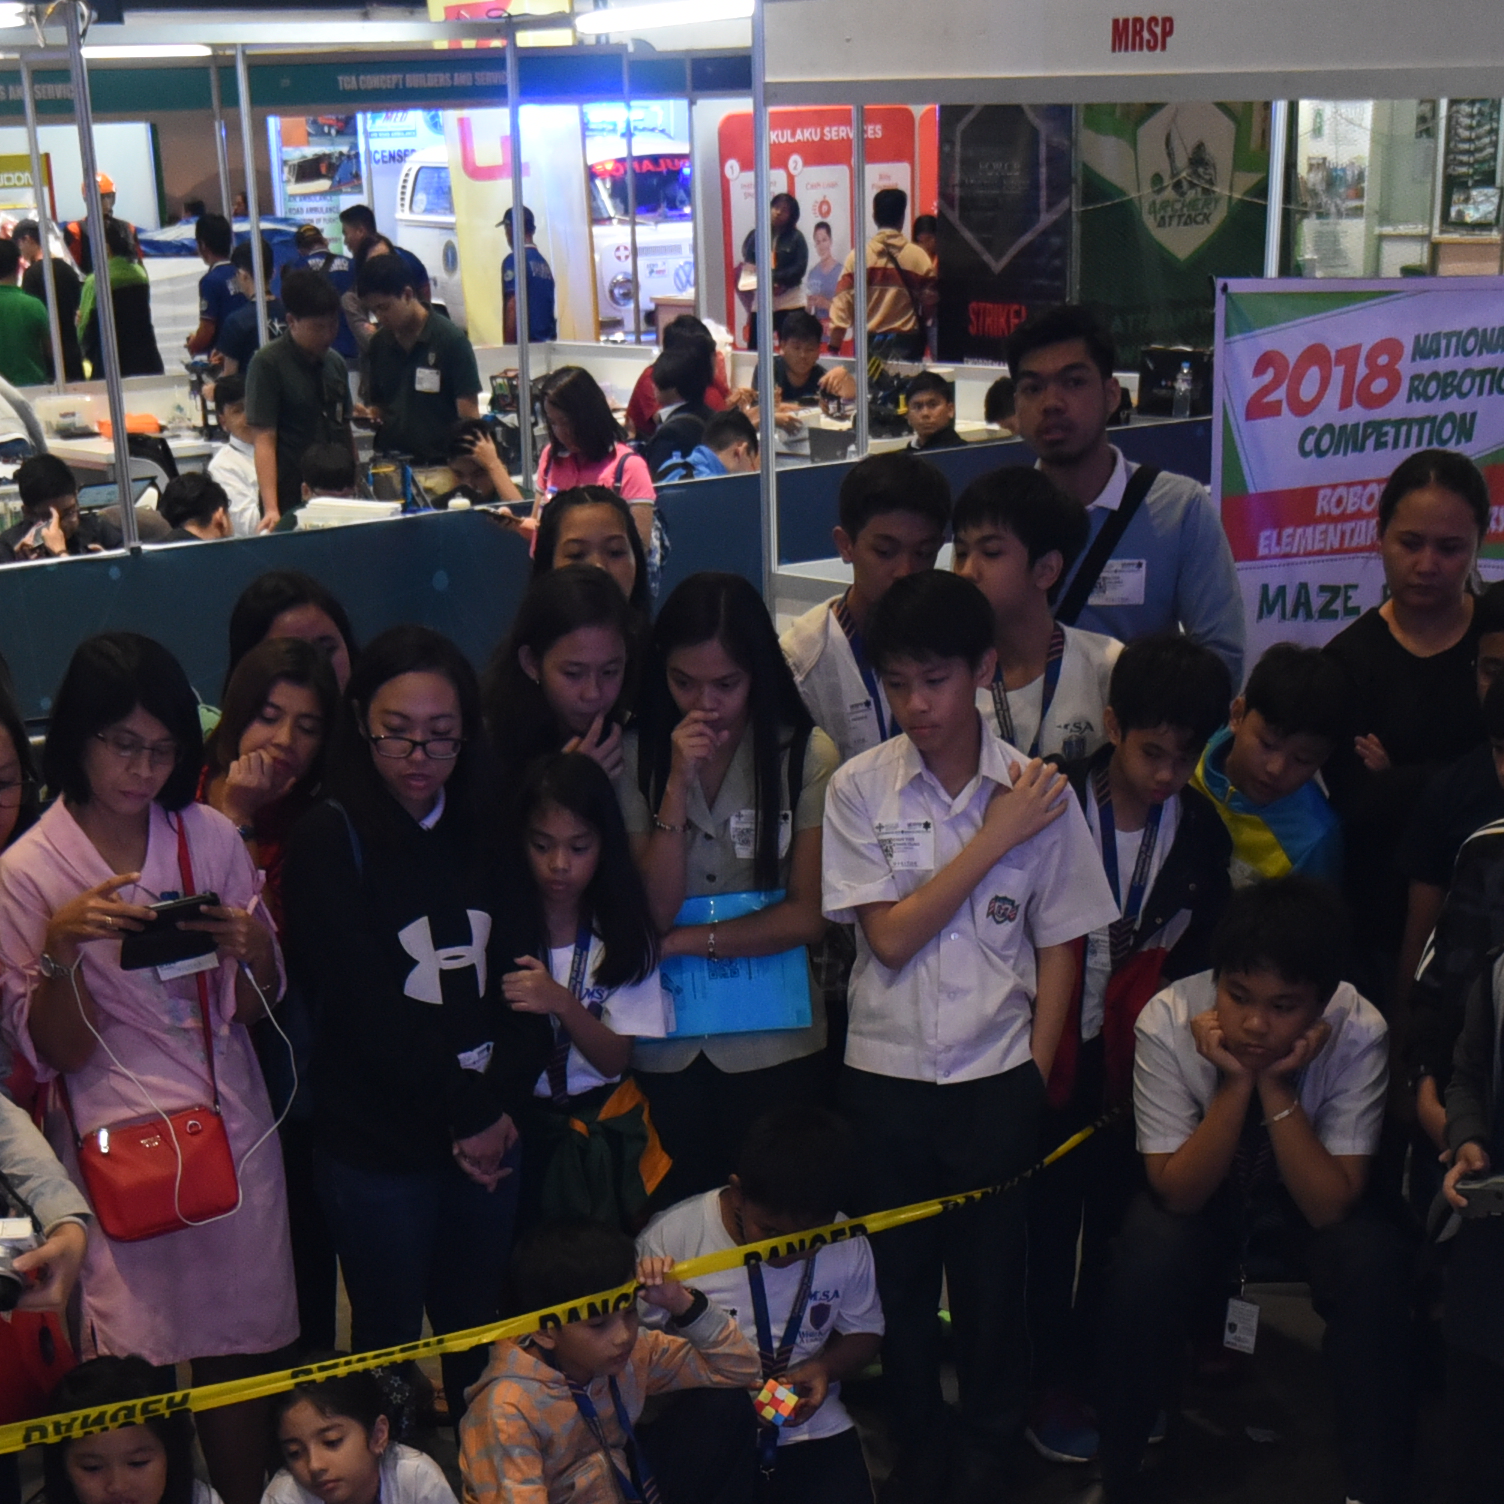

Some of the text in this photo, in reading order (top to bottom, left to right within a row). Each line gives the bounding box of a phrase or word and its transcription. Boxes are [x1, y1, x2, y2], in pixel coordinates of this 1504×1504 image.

[1111, 16, 1174, 53] MRSP
[8, 84, 25, 100] AN
[769, 124, 883, 144] KULAKU SERVCES
[1156, 209, 1213, 229] ATTACK
[1245, 337, 1404, 422] 2018
[1298, 411, 1478, 459] COMPETITION
[1257, 519, 1378, 558] ELEMENTAR
[1256, 581, 1362, 623] MAZE
